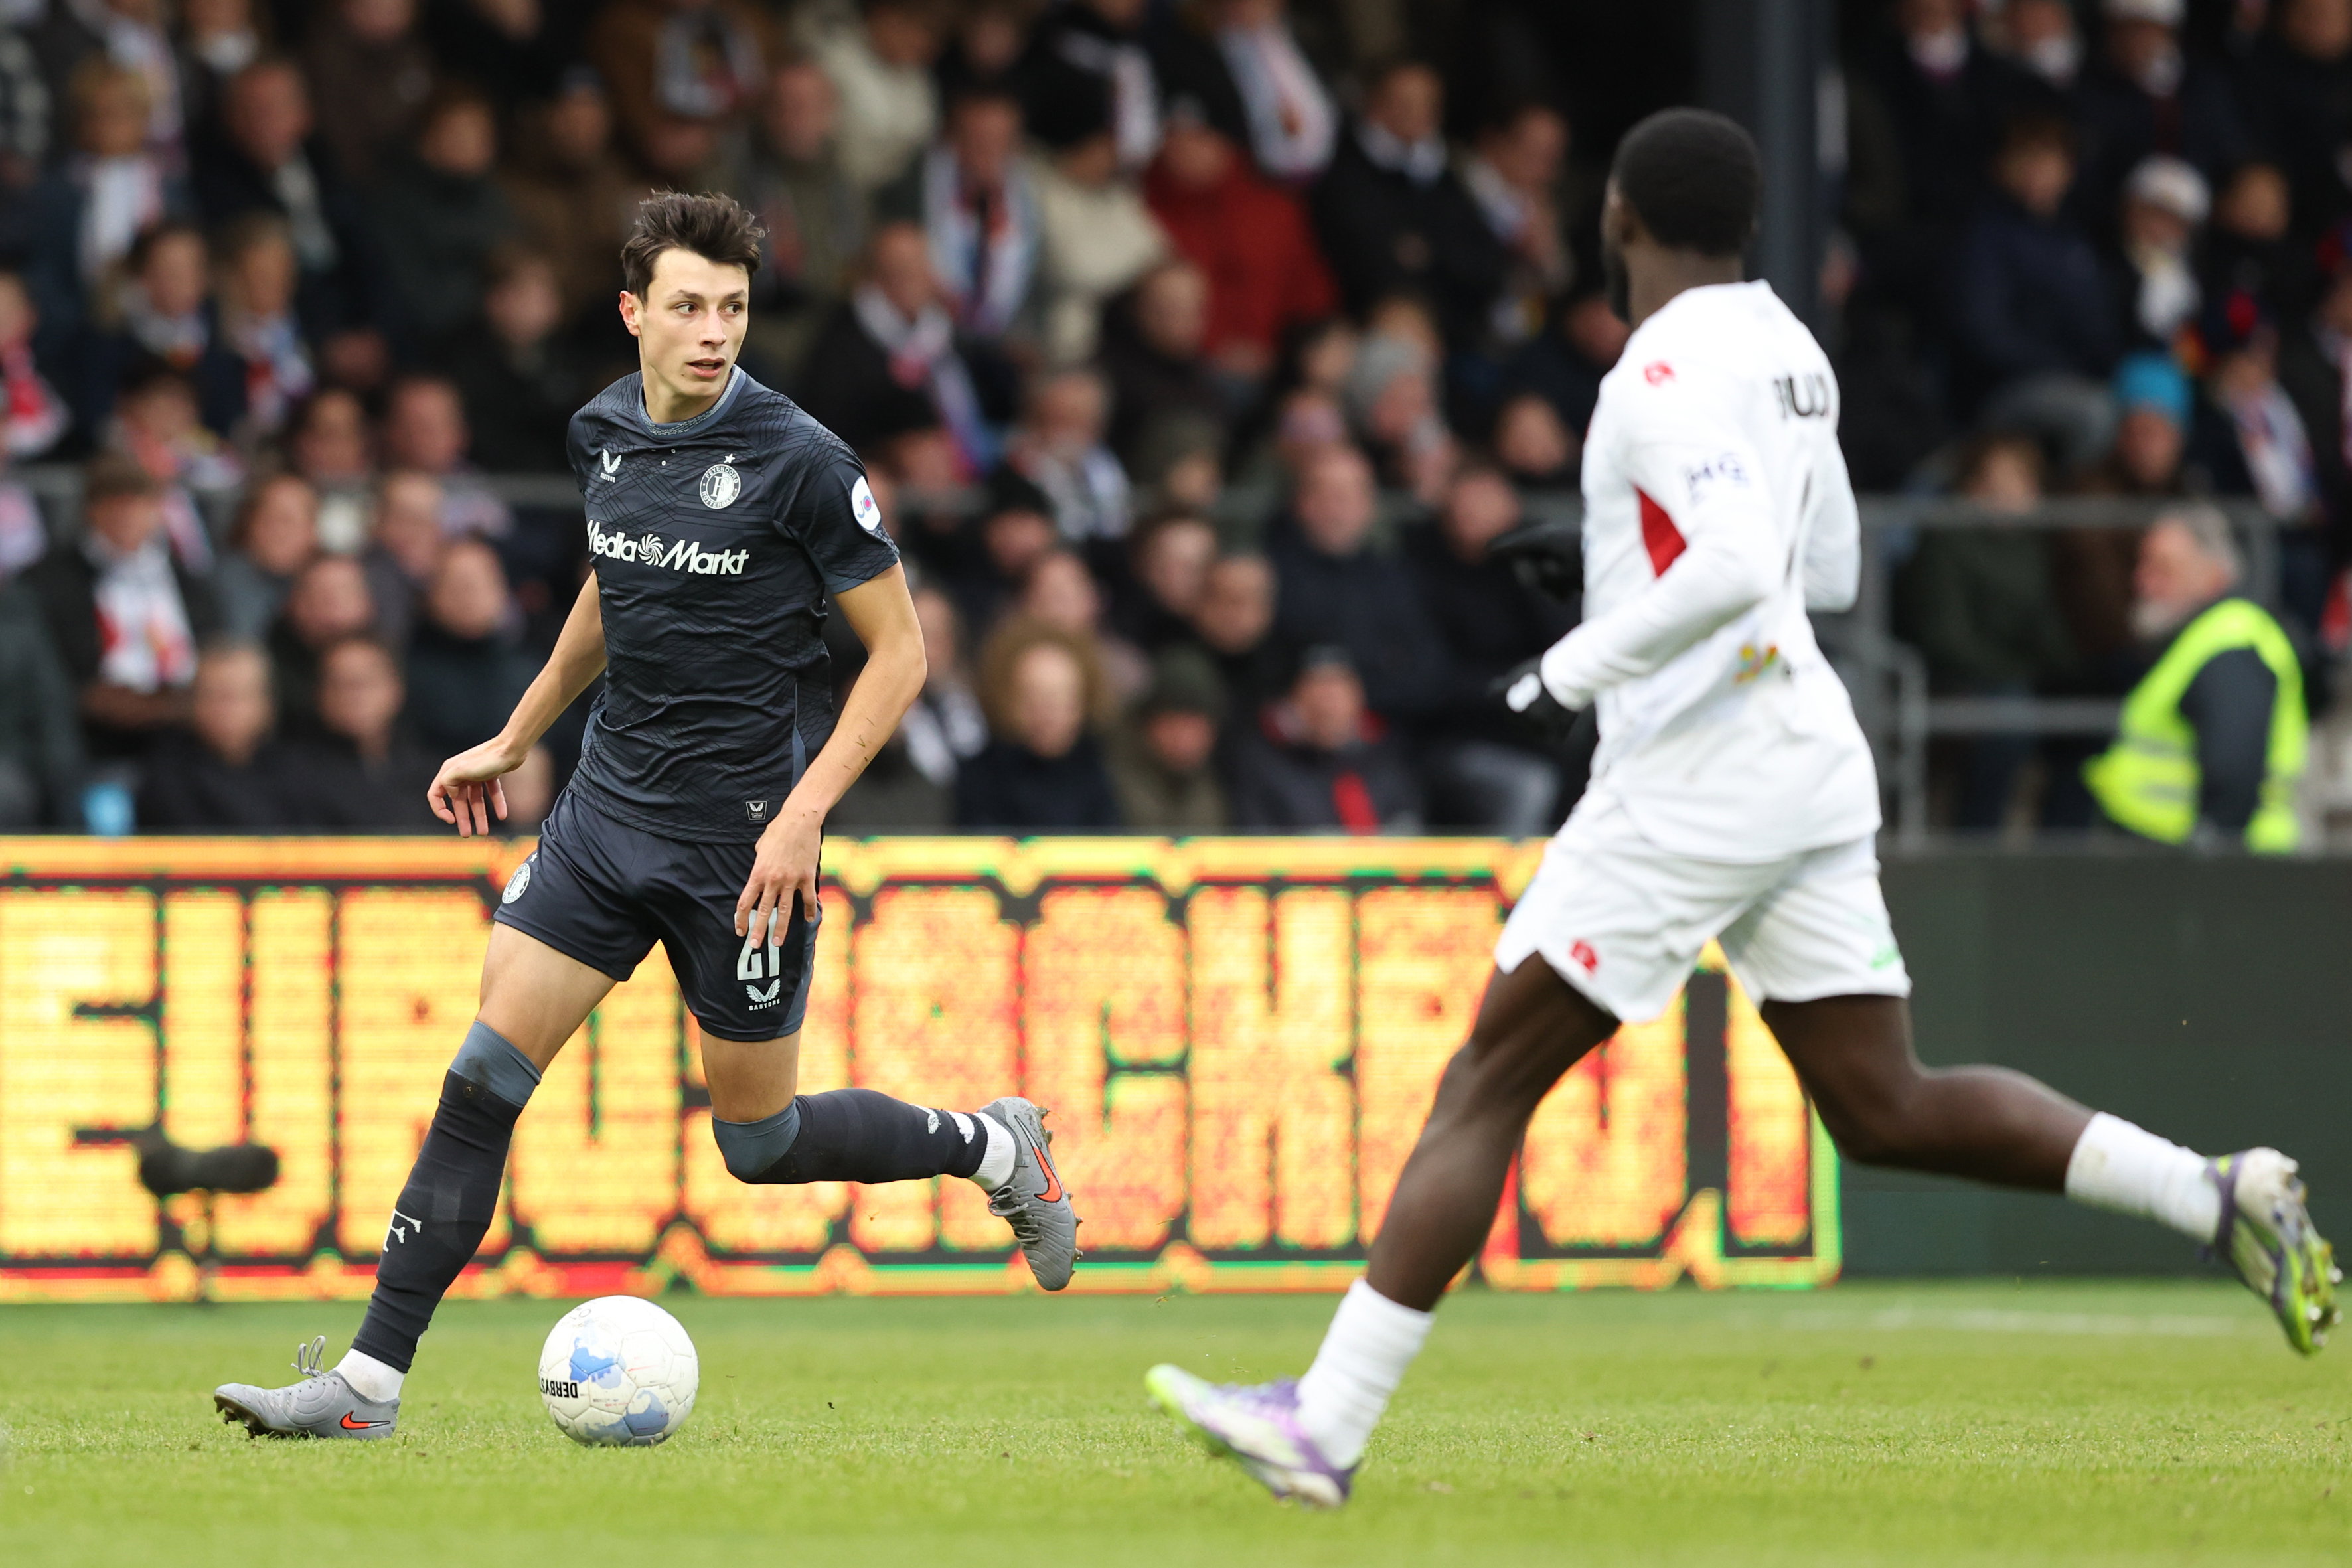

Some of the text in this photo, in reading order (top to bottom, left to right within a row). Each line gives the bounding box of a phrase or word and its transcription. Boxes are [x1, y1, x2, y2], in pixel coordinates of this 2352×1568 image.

[705, 466, 738, 483] FEYENOORD
[702, 491, 735, 507] ROTTERDAM
[587, 520, 749, 575] Media Markt
[734, 907, 780, 980] 21
[749, 998, 781, 1011] CASTORE
